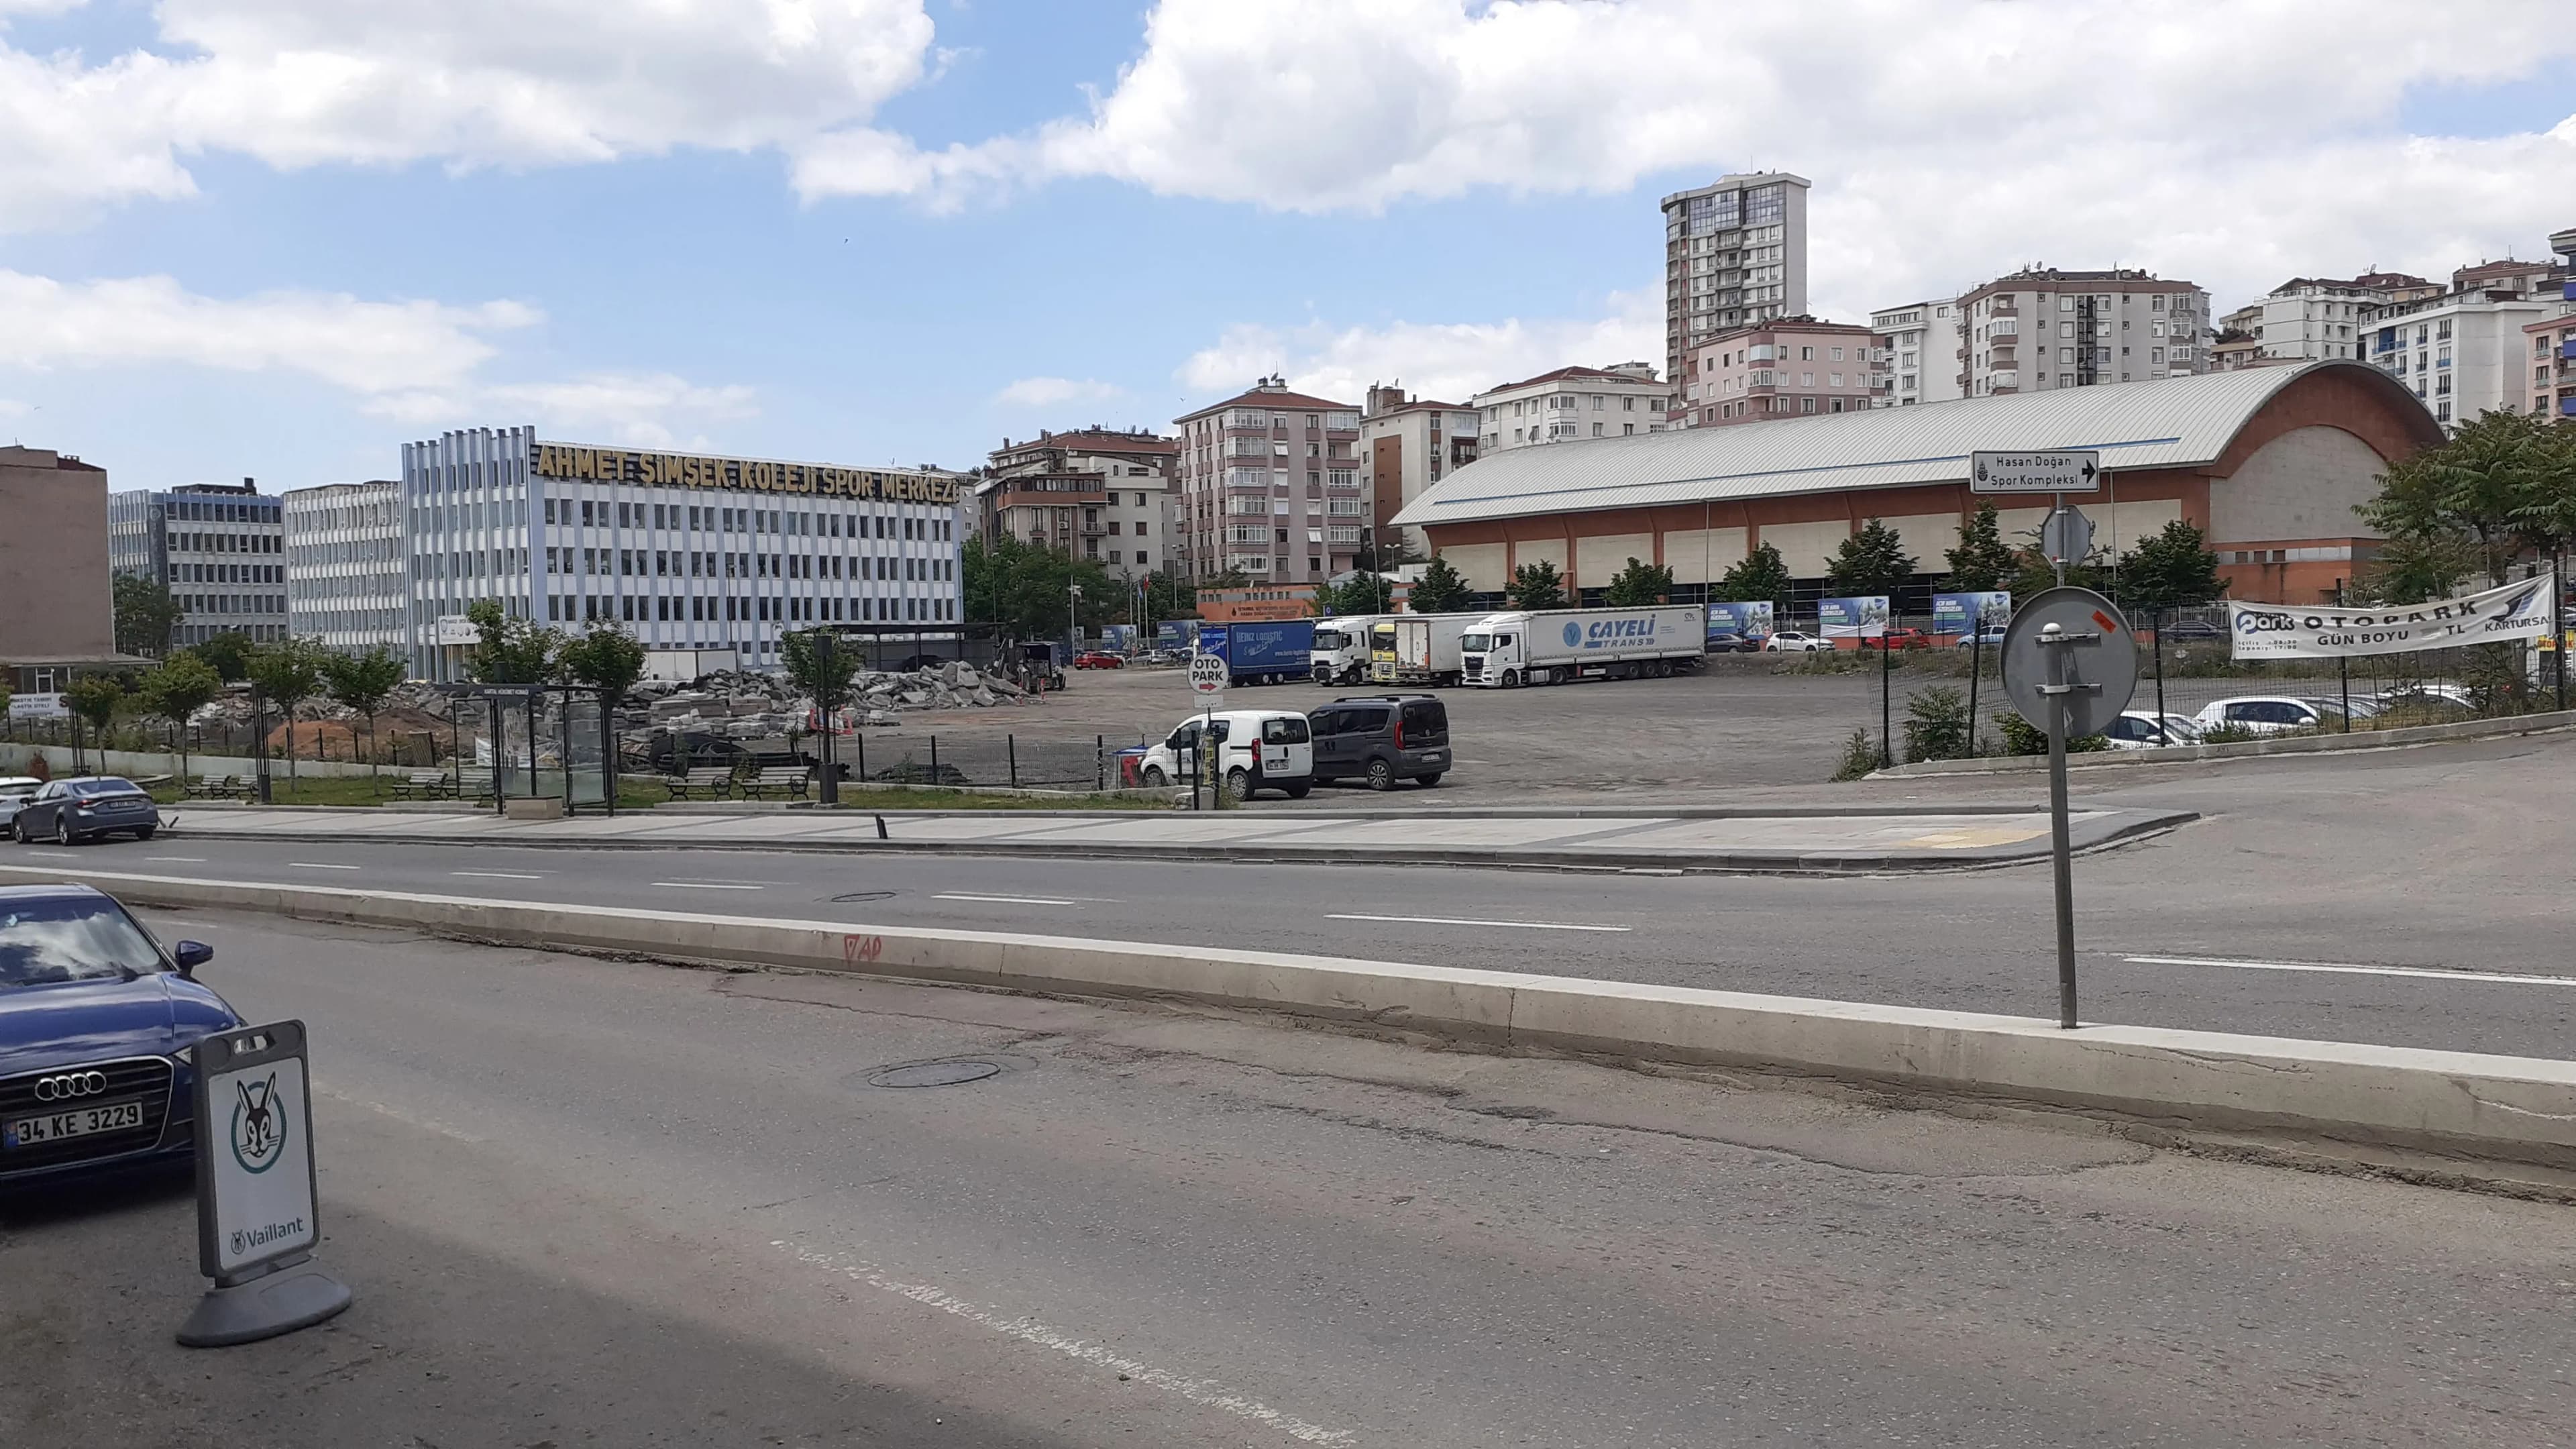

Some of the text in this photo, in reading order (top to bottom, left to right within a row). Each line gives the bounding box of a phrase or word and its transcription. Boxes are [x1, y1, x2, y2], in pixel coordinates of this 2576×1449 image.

[1996, 455, 2072, 468] Hasan Doğan
[537, 445, 627, 480] AHMET
[739, 460, 817, 493] KOLEJİ
[822, 468, 873, 496] SPOR
[881, 474, 957, 503] MERKEZİ
[1991, 474, 2078, 488] Spor Kompleksi
[2304, 600, 2477, 629] OTOPARK
[1589, 614, 1656, 641] ÇAYELİ
[2317, 633, 2355, 646] GÜN
[2361, 631, 2409, 644] BOYU
[2446, 625, 2465, 635] TL
[1603, 639, 1644, 648] TRANS
[1195, 659, 1220, 669] OTO
[1192, 671, 1223, 681] PARK
[19, 1121, 44, 1142] 34
[52, 1115, 78, 1136] KE
[87, 1106, 138, 1131] 3229
[246, 1218, 304, 1248] Vaillant
